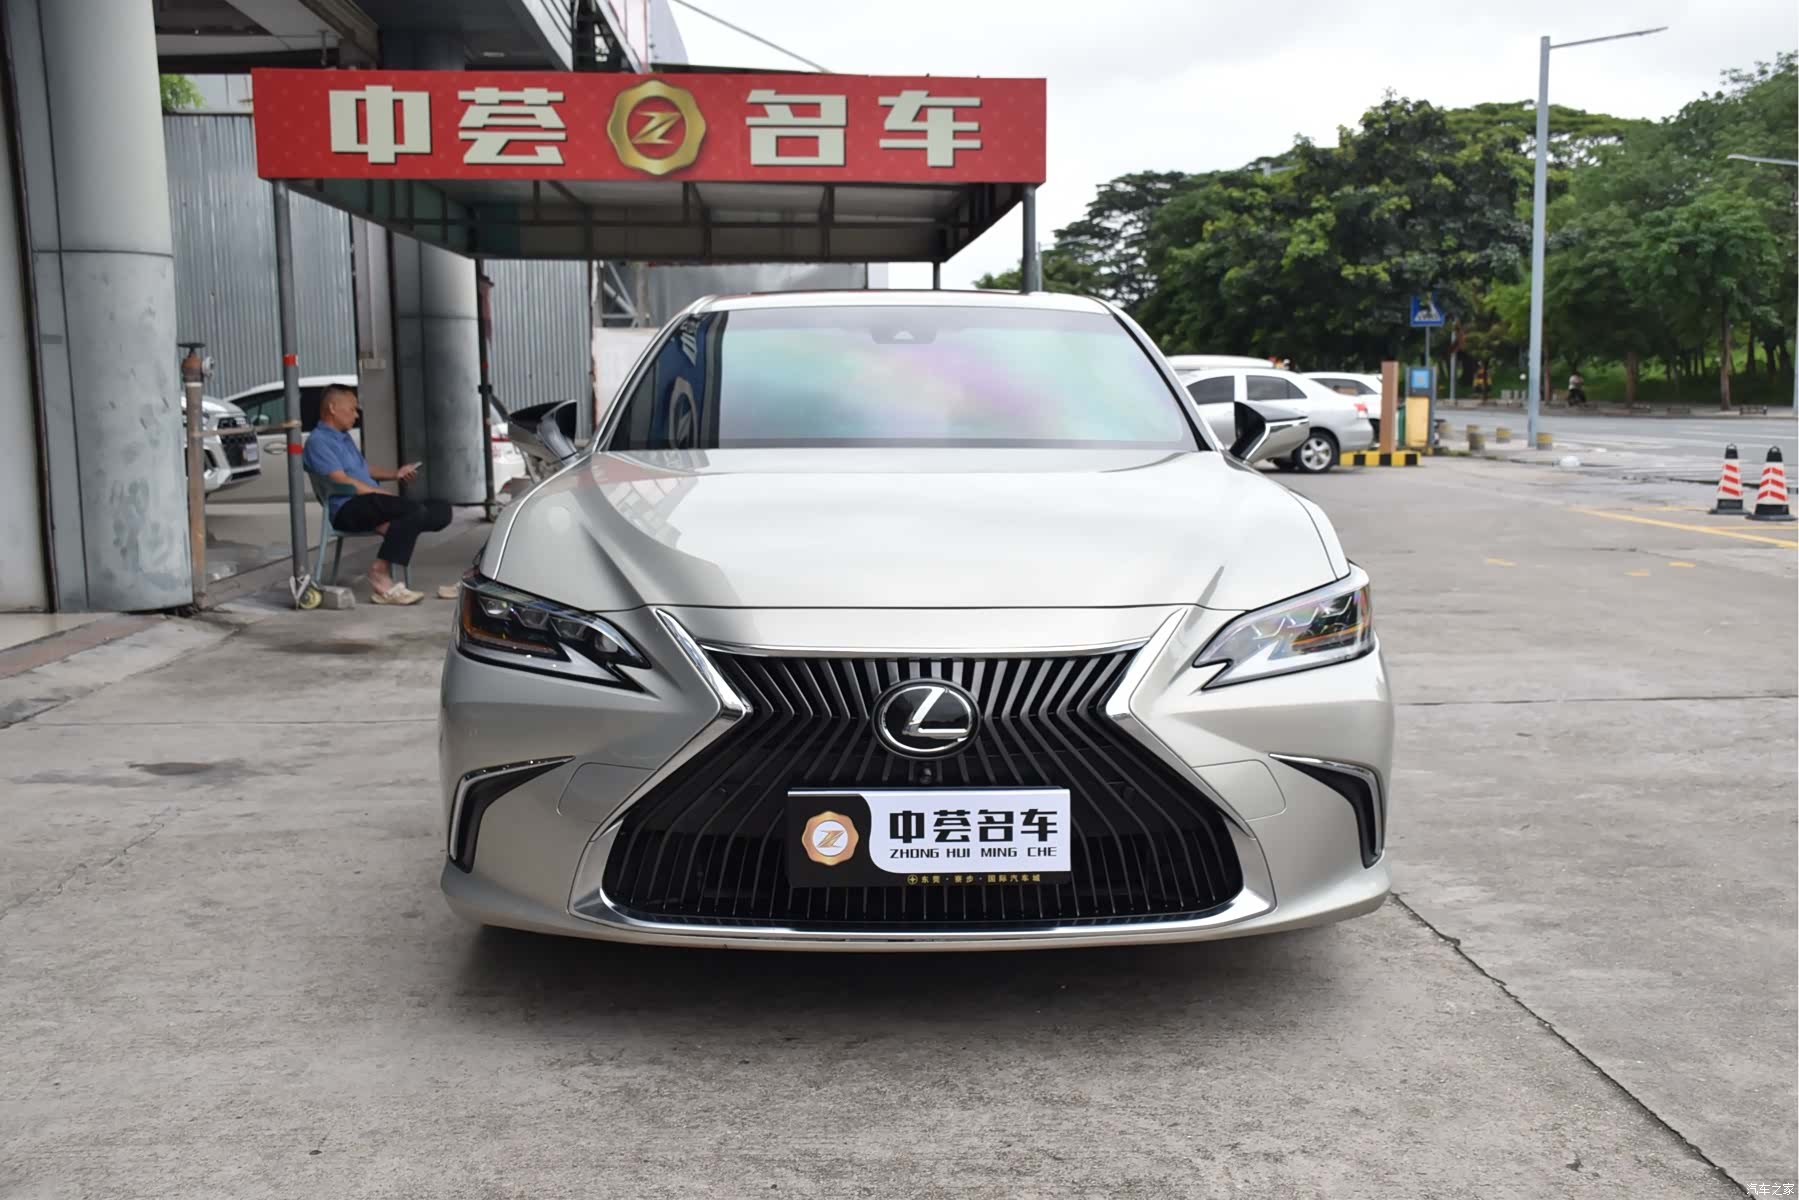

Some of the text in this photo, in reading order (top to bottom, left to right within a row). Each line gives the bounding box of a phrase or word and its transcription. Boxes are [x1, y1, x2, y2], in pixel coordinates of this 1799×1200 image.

[889, 808, 1058, 844] 中荟名车
[890, 846, 1057, 859] ZHONG HUI MING CHE
